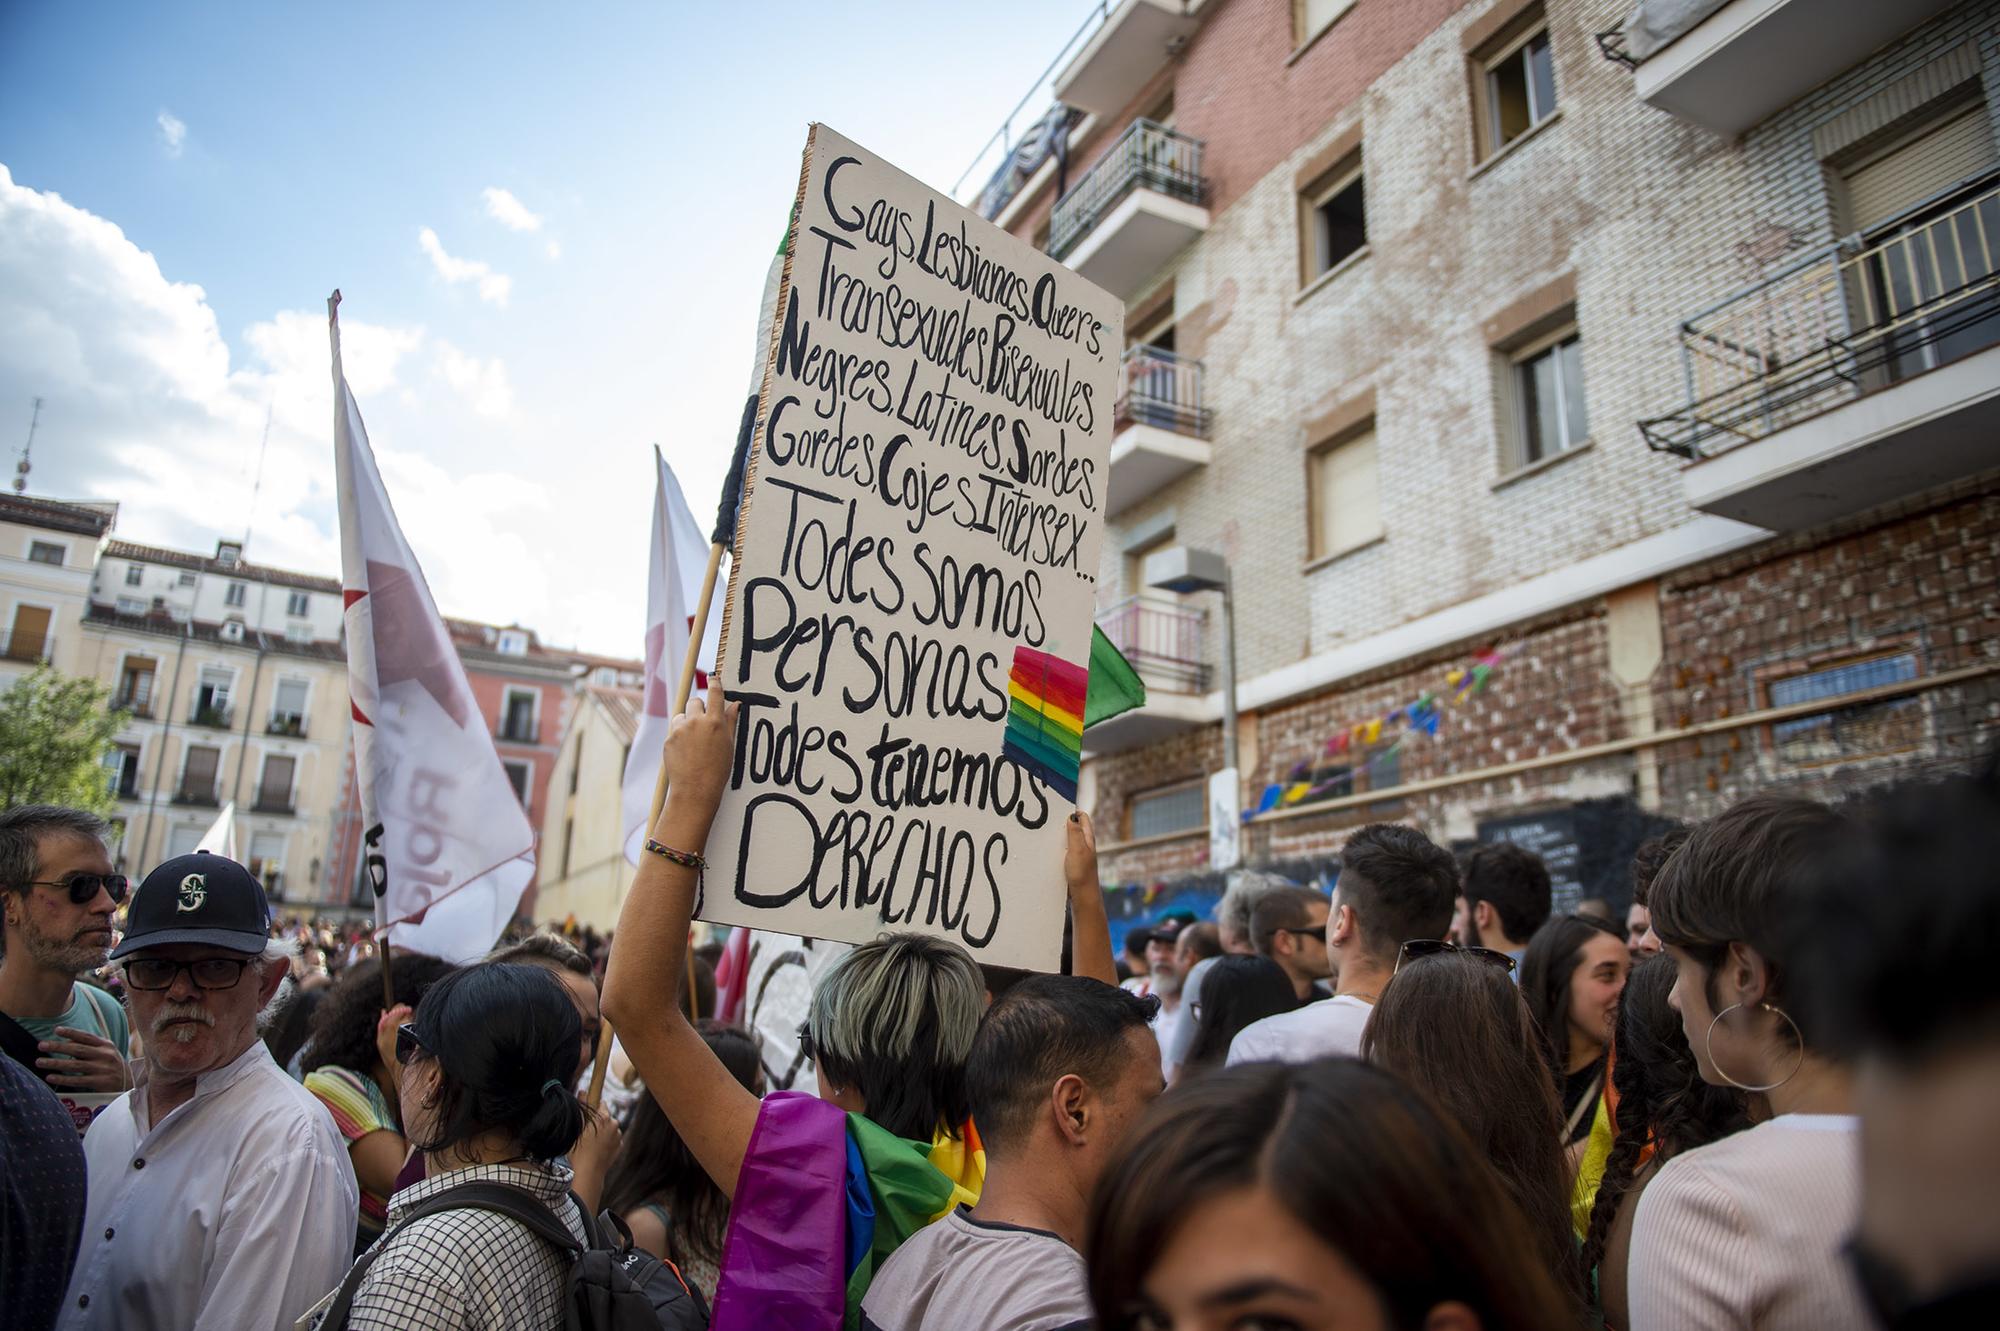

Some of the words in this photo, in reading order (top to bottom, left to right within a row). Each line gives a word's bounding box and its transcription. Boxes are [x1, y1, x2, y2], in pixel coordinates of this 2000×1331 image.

[823, 156, 915, 280] Gays,
[776, 285, 894, 419] Negres,
[765, 395, 878, 493] Gordes,
[764, 476, 905, 616] Todes
[911, 542, 1047, 648] somos
[738, 576, 1008, 723] Personas
[723, 690, 864, 804] Todes
[866, 722, 1050, 830] tenemos
